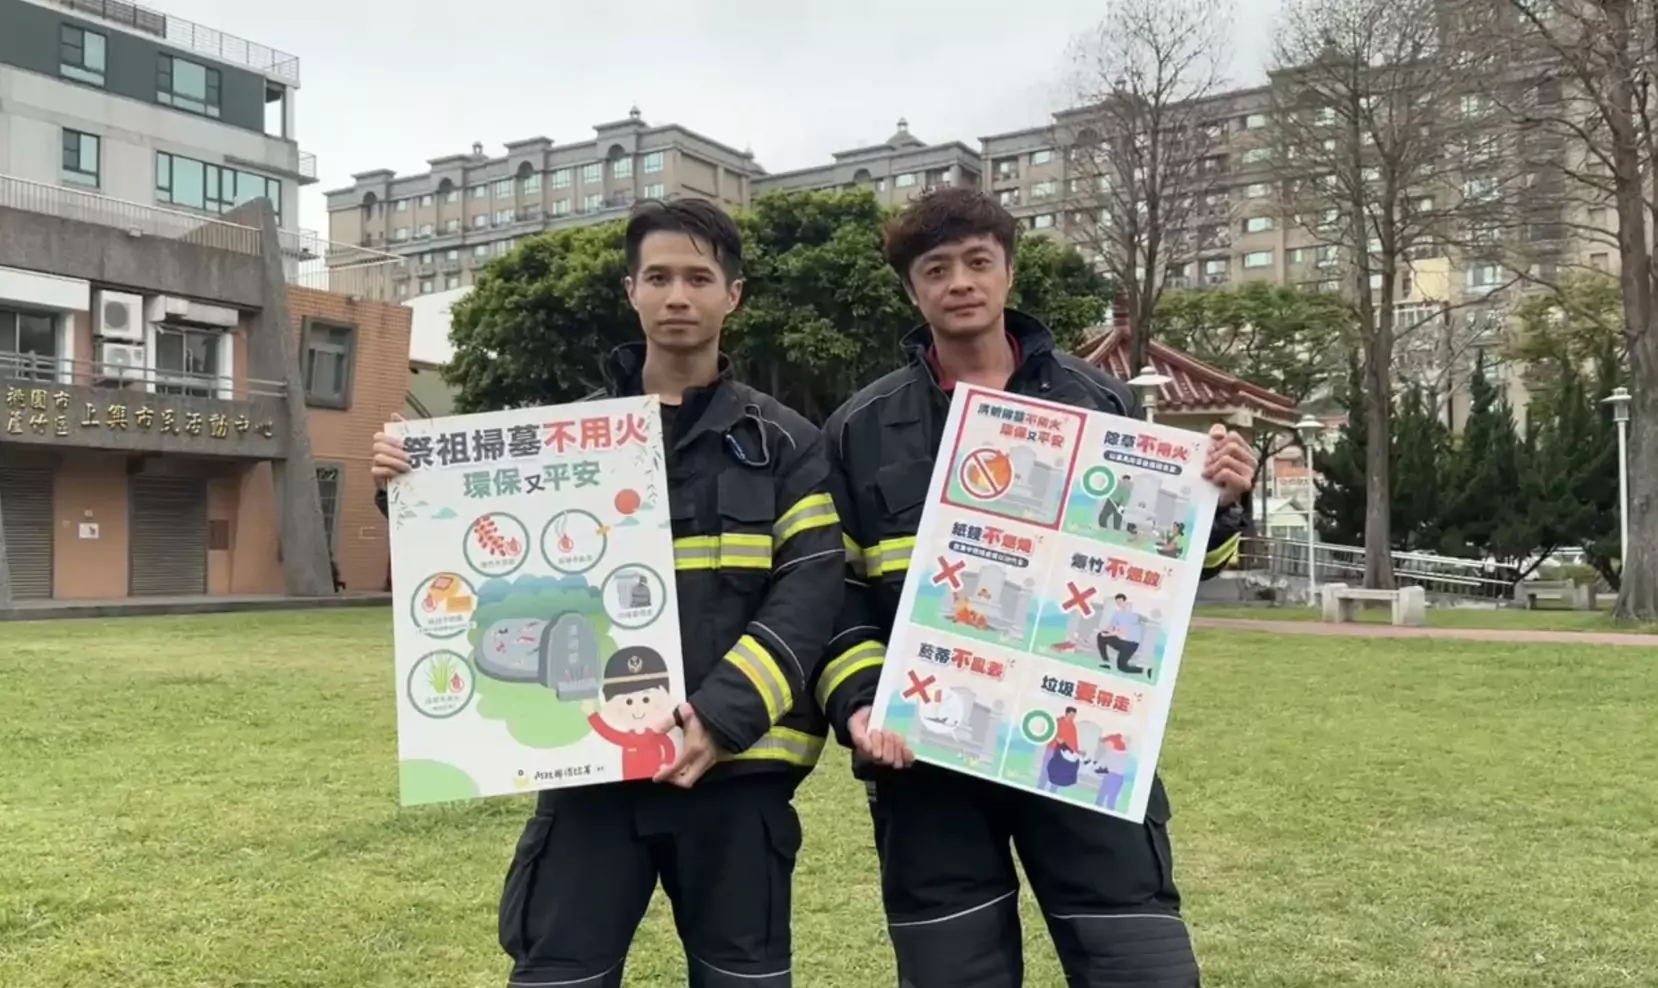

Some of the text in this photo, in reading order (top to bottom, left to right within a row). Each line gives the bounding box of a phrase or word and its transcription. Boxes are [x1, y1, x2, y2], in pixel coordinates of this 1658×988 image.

[80, 402, 273, 438] 上興市民活動中心
[403, 413, 648, 469] 祭祖掃墓不用火
[1103, 430, 1187, 462] 除草不用火
[463, 459, 602, 500] 環保又平安
[1040, 674, 1130, 713] 垃圾要帶走
